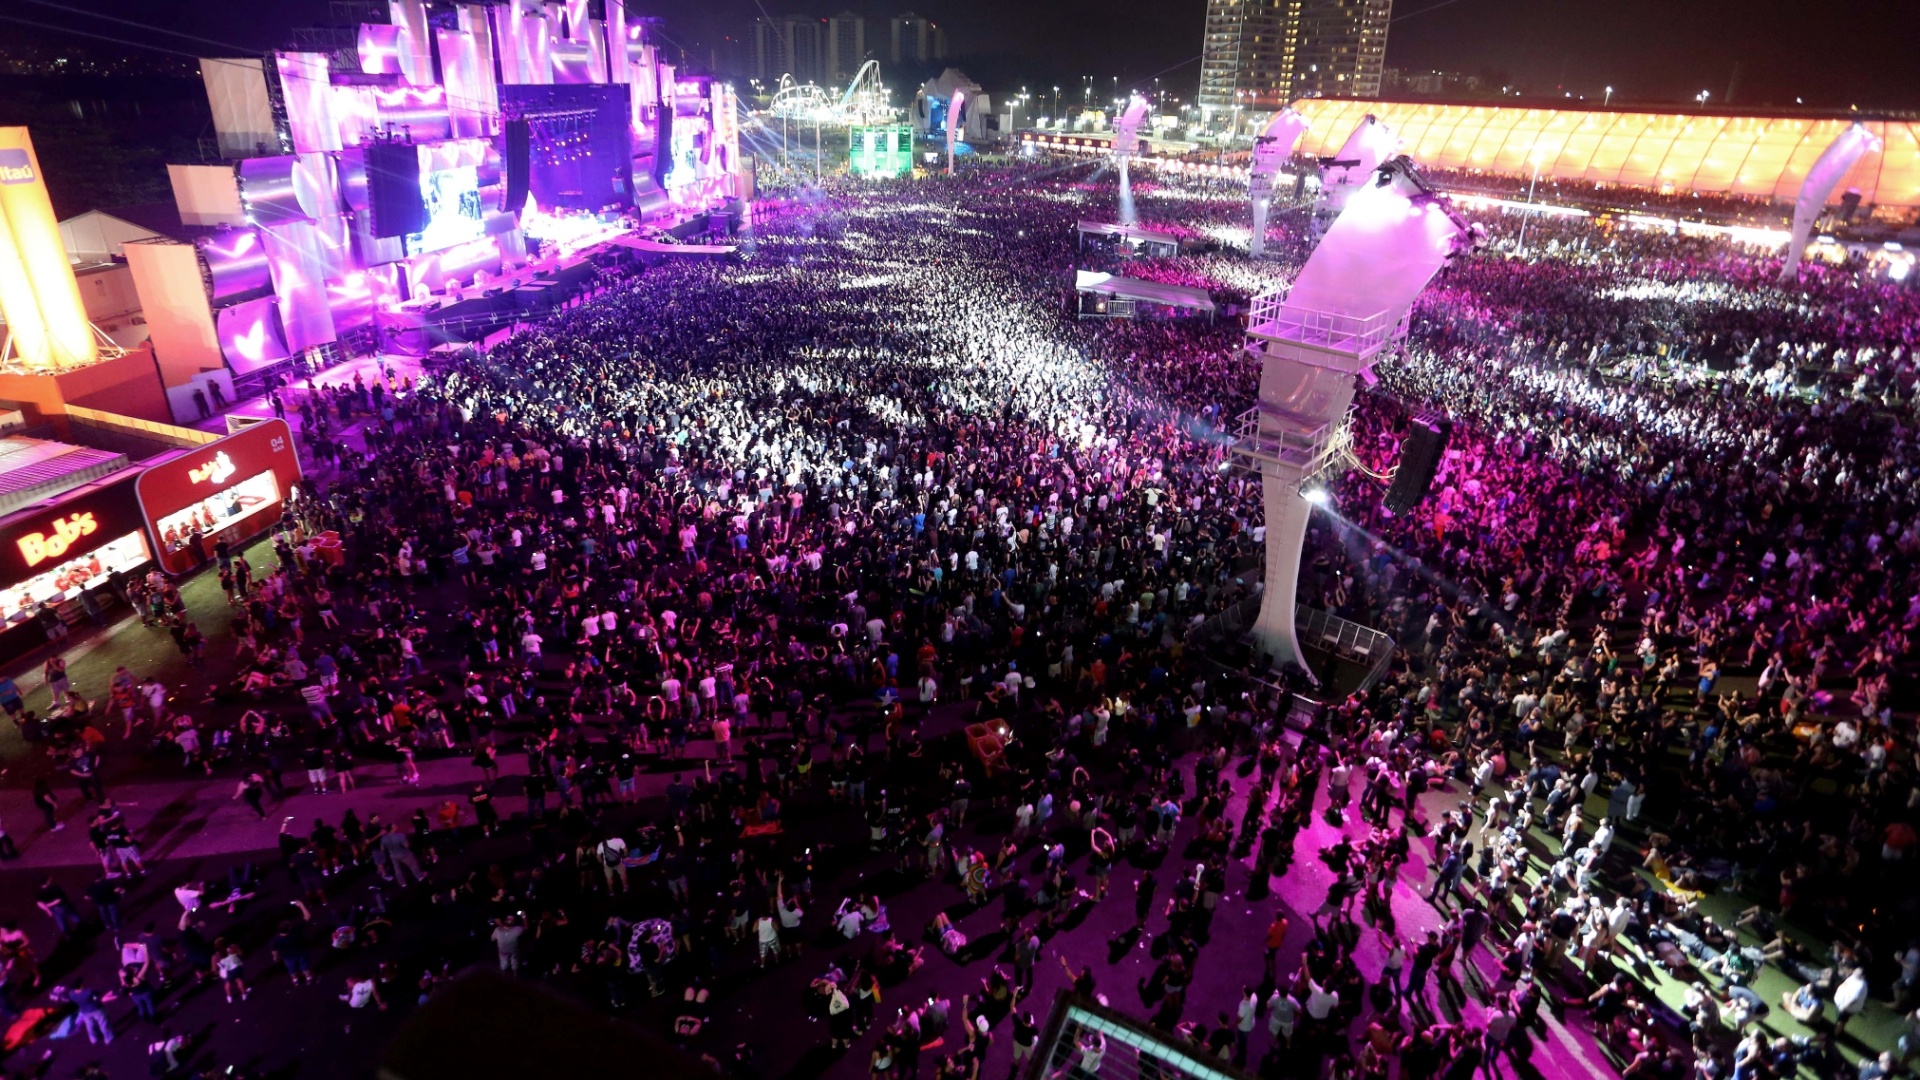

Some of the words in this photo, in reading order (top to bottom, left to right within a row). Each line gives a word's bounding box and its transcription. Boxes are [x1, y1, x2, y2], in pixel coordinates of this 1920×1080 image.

[0, 164, 34, 180] Itaú
[270, 435, 284, 447] 04
[16, 512, 98, 567] Bob's
